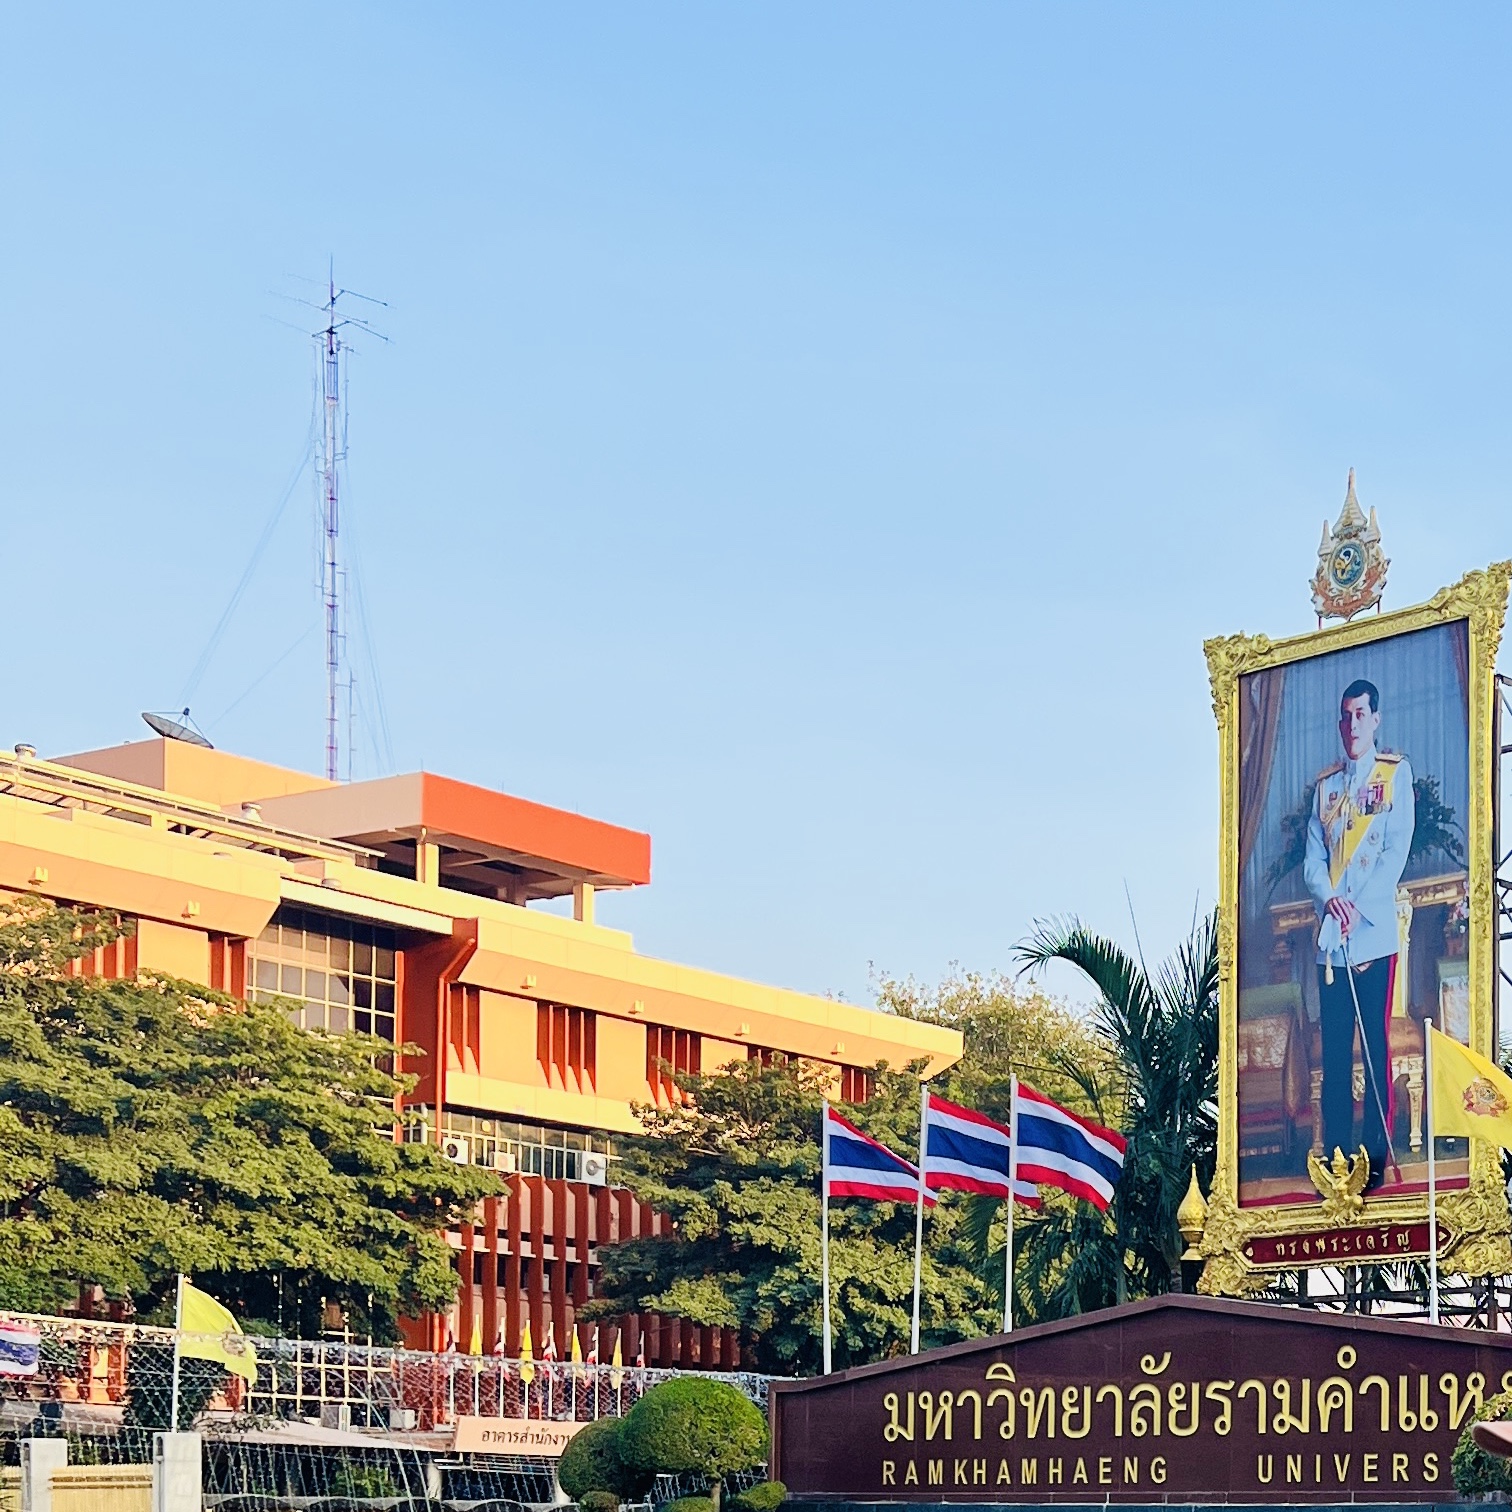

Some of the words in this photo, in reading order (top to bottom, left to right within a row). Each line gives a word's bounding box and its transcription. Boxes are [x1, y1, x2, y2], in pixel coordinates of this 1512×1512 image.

[1275, 1227, 1411, 1258] ทรงพระเจริญ
[883, 1457, 1167, 1485] RAMKHAMHAENG
